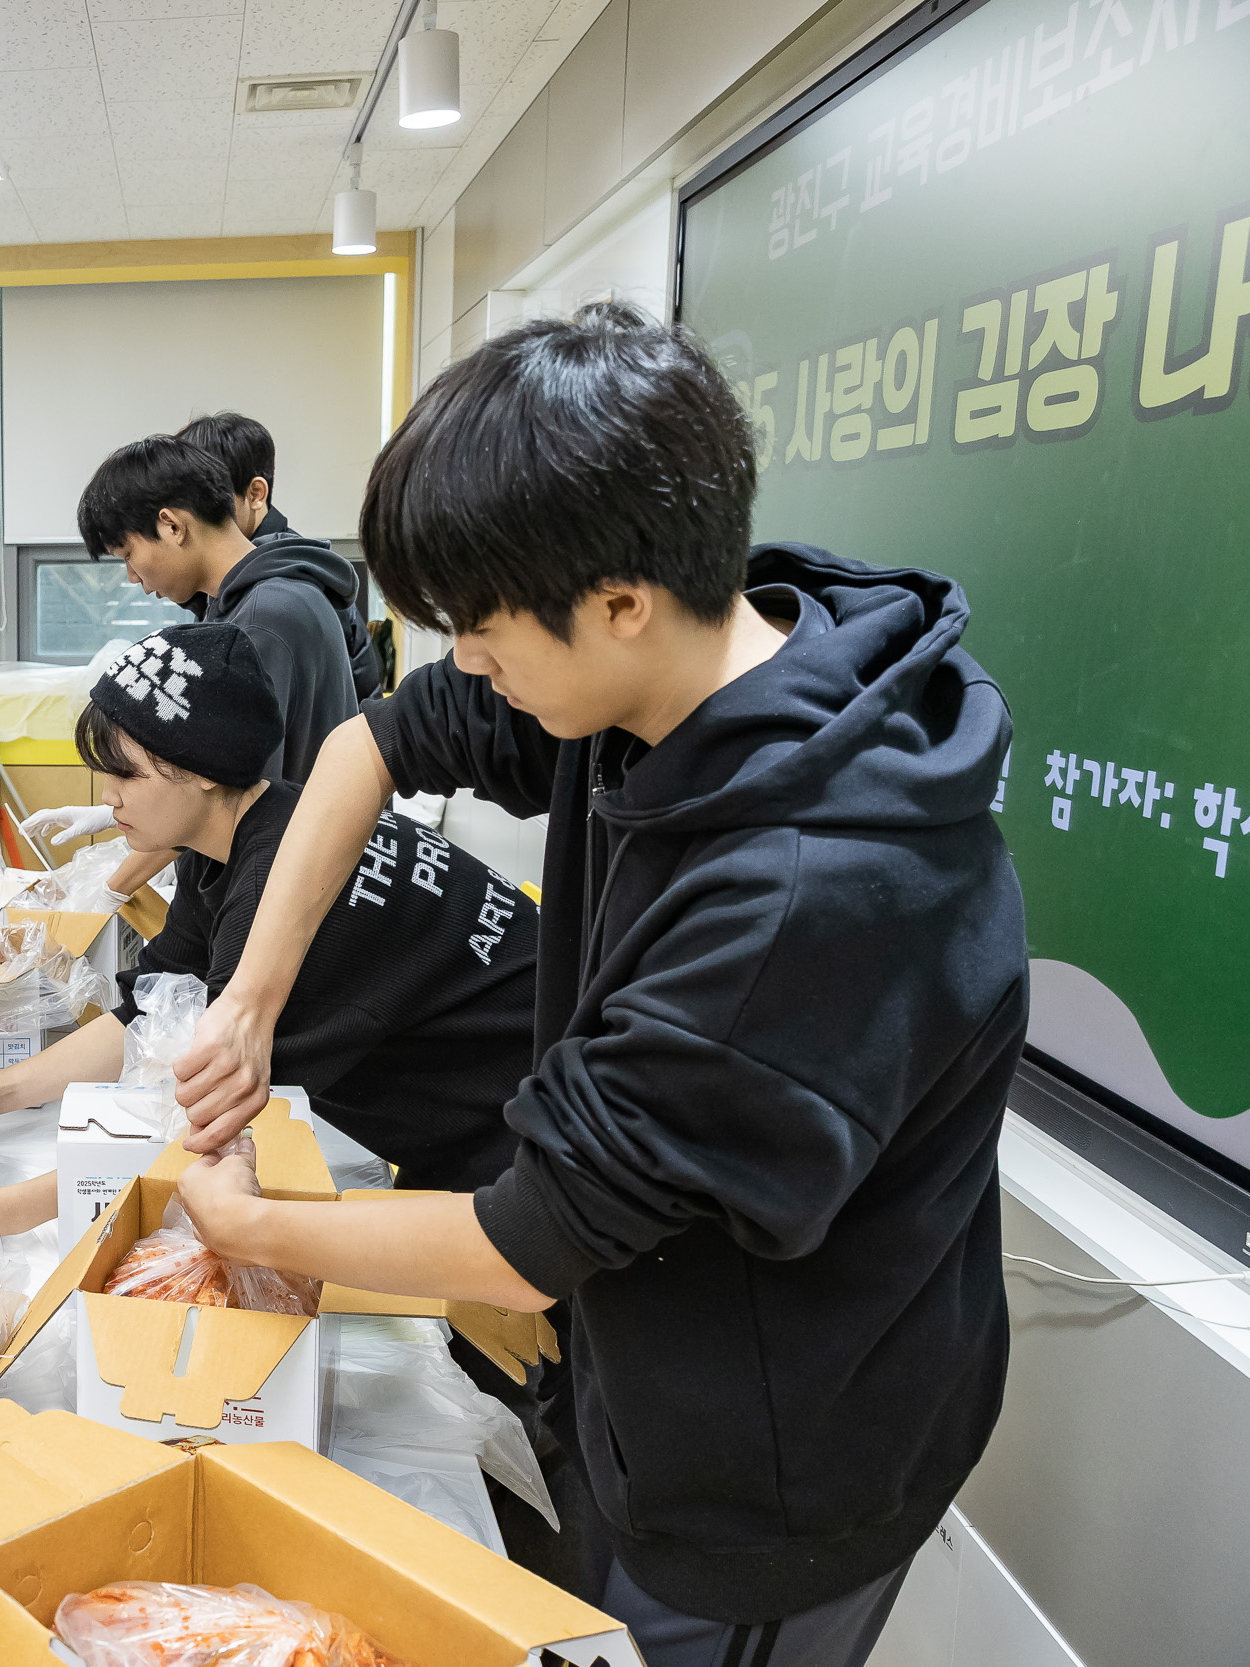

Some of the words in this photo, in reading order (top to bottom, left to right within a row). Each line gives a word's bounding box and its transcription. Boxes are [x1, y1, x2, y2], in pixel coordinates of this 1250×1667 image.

[768, 145, 852, 261] 광진구
[785, 318, 939, 464] 사랑의
[954, 262, 1119, 444] 김장
[348, 834, 399, 907] THE
[1044, 749, 1175, 831] 참가자:
[1193, 782, 1250, 879] 학
[468, 883, 516, 966] ART
